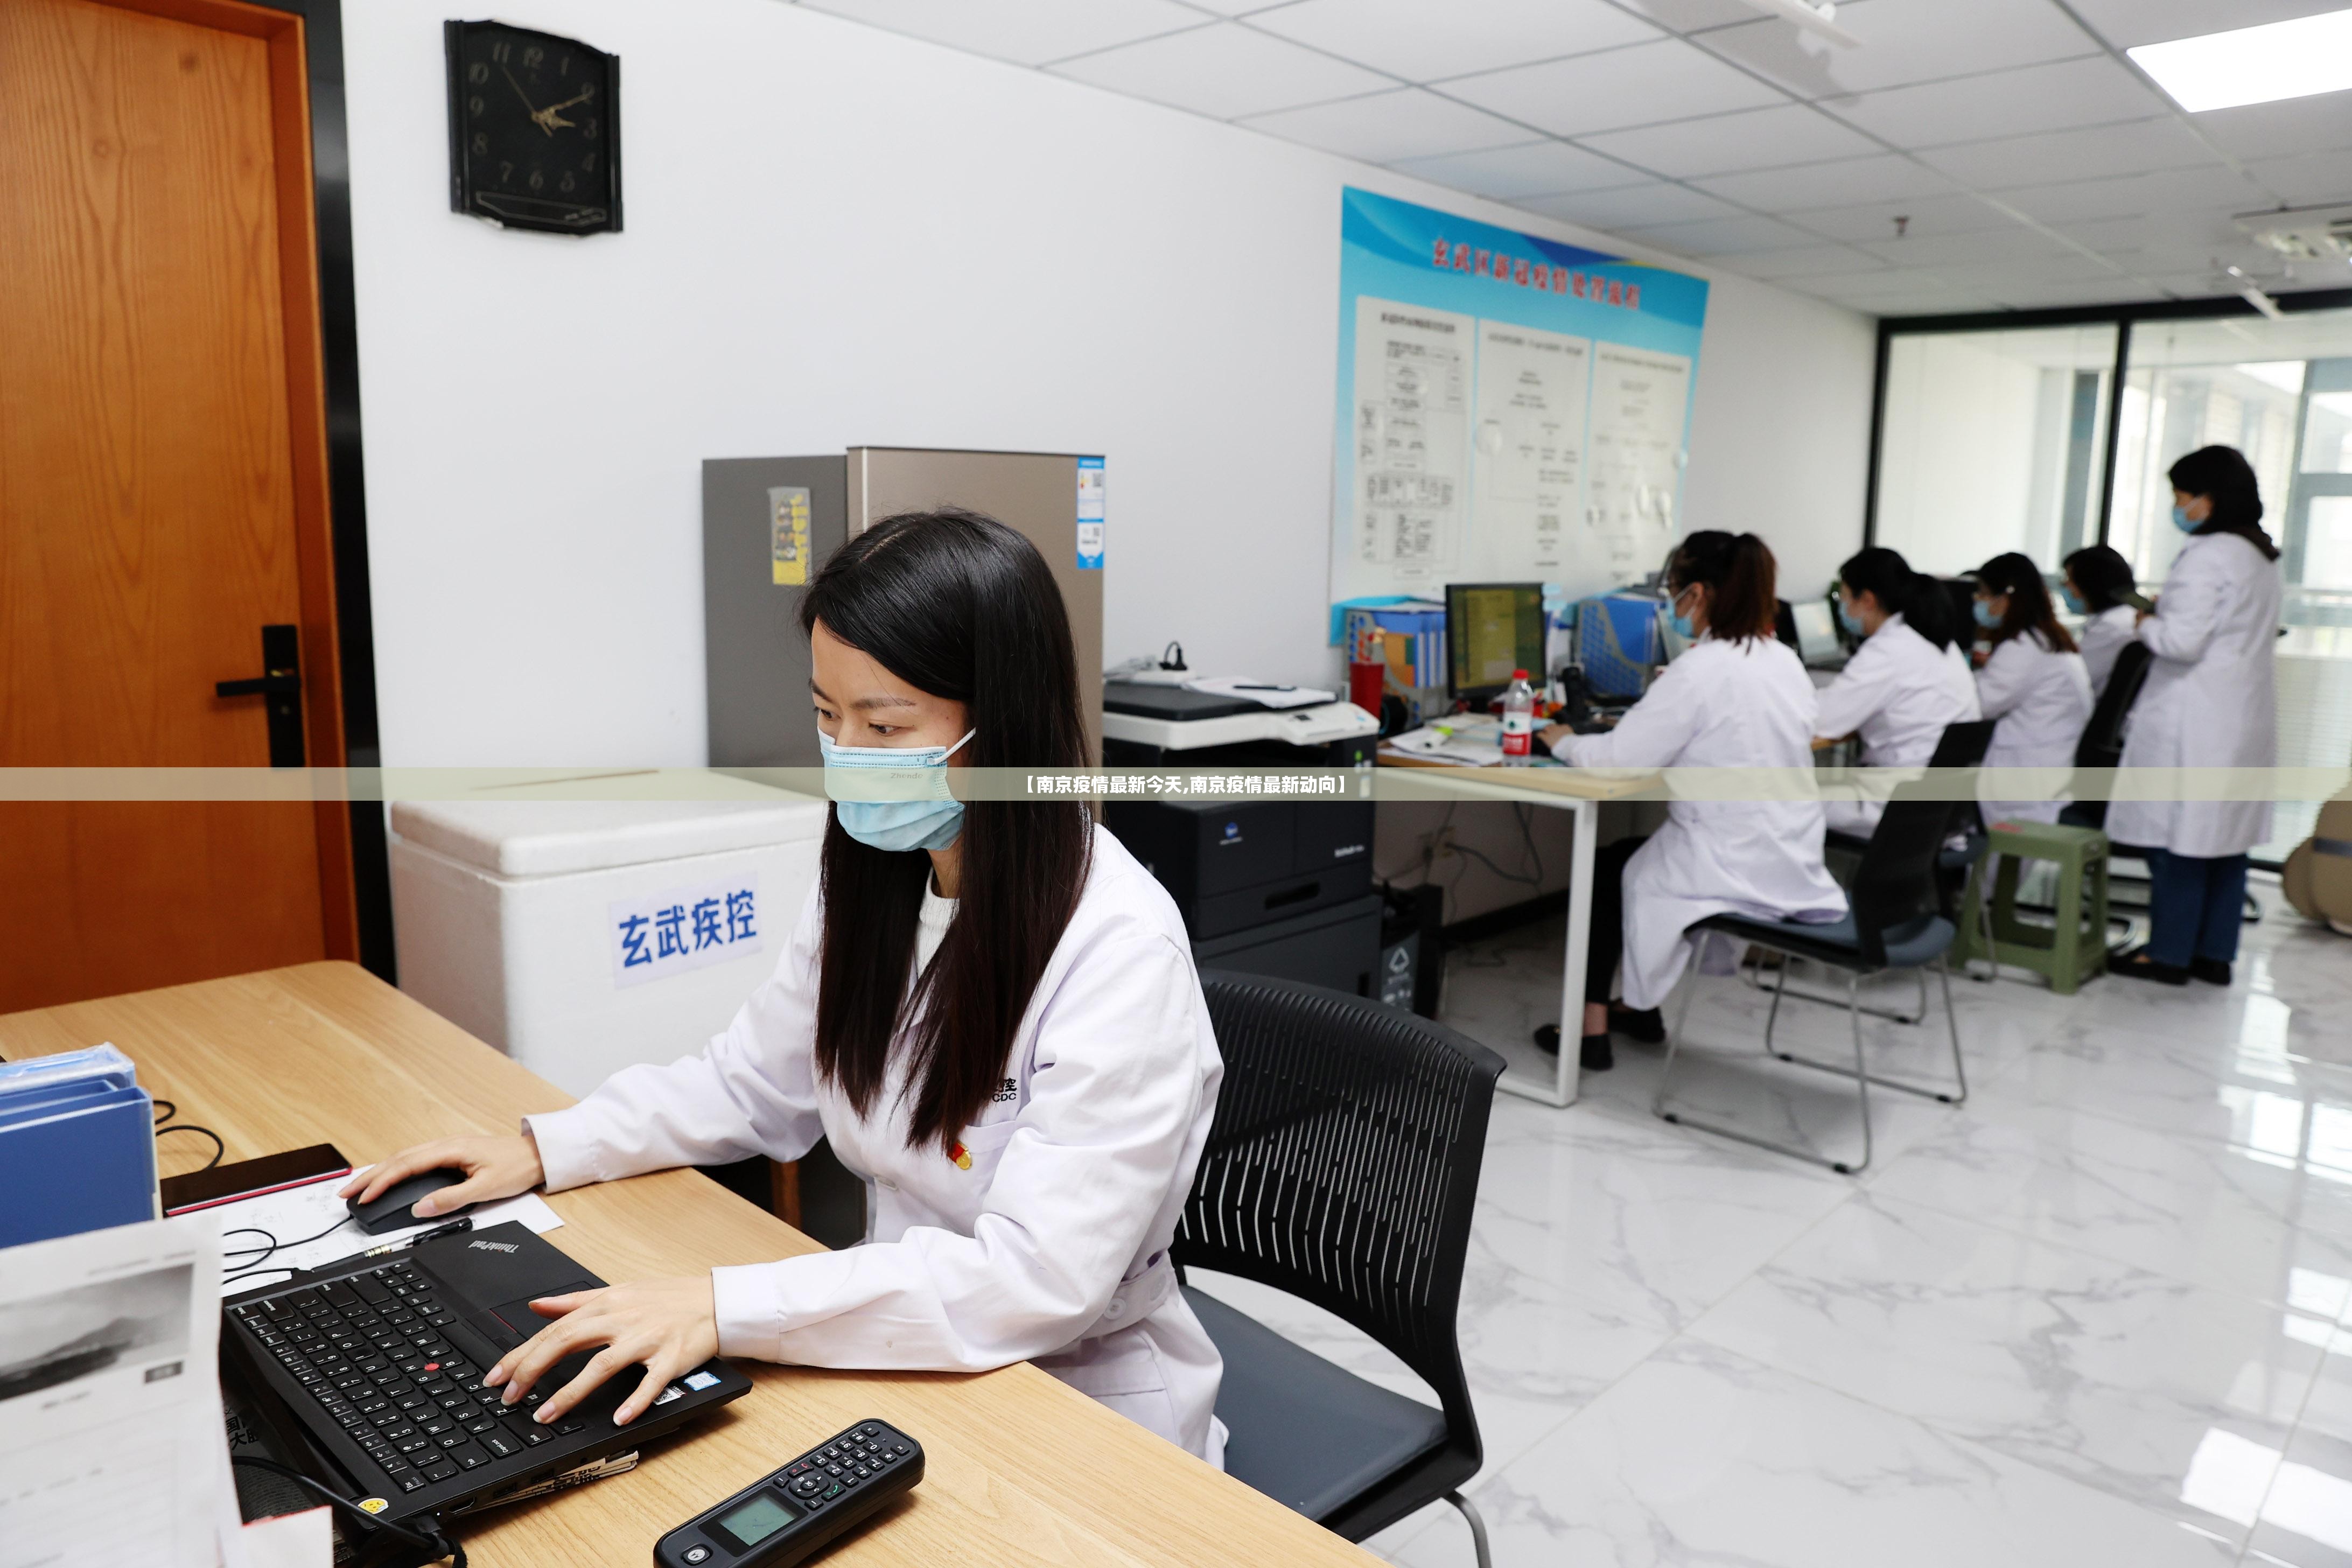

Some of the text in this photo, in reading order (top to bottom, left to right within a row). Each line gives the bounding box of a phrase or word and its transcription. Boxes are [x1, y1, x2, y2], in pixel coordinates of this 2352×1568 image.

[619, 889, 757, 968] 玄武疾控
[992, 1093, 1017, 1102] CDC
[468, 1240, 519, 1254] ThinkPad
[492, 1438, 509, 1453] CapsLock
